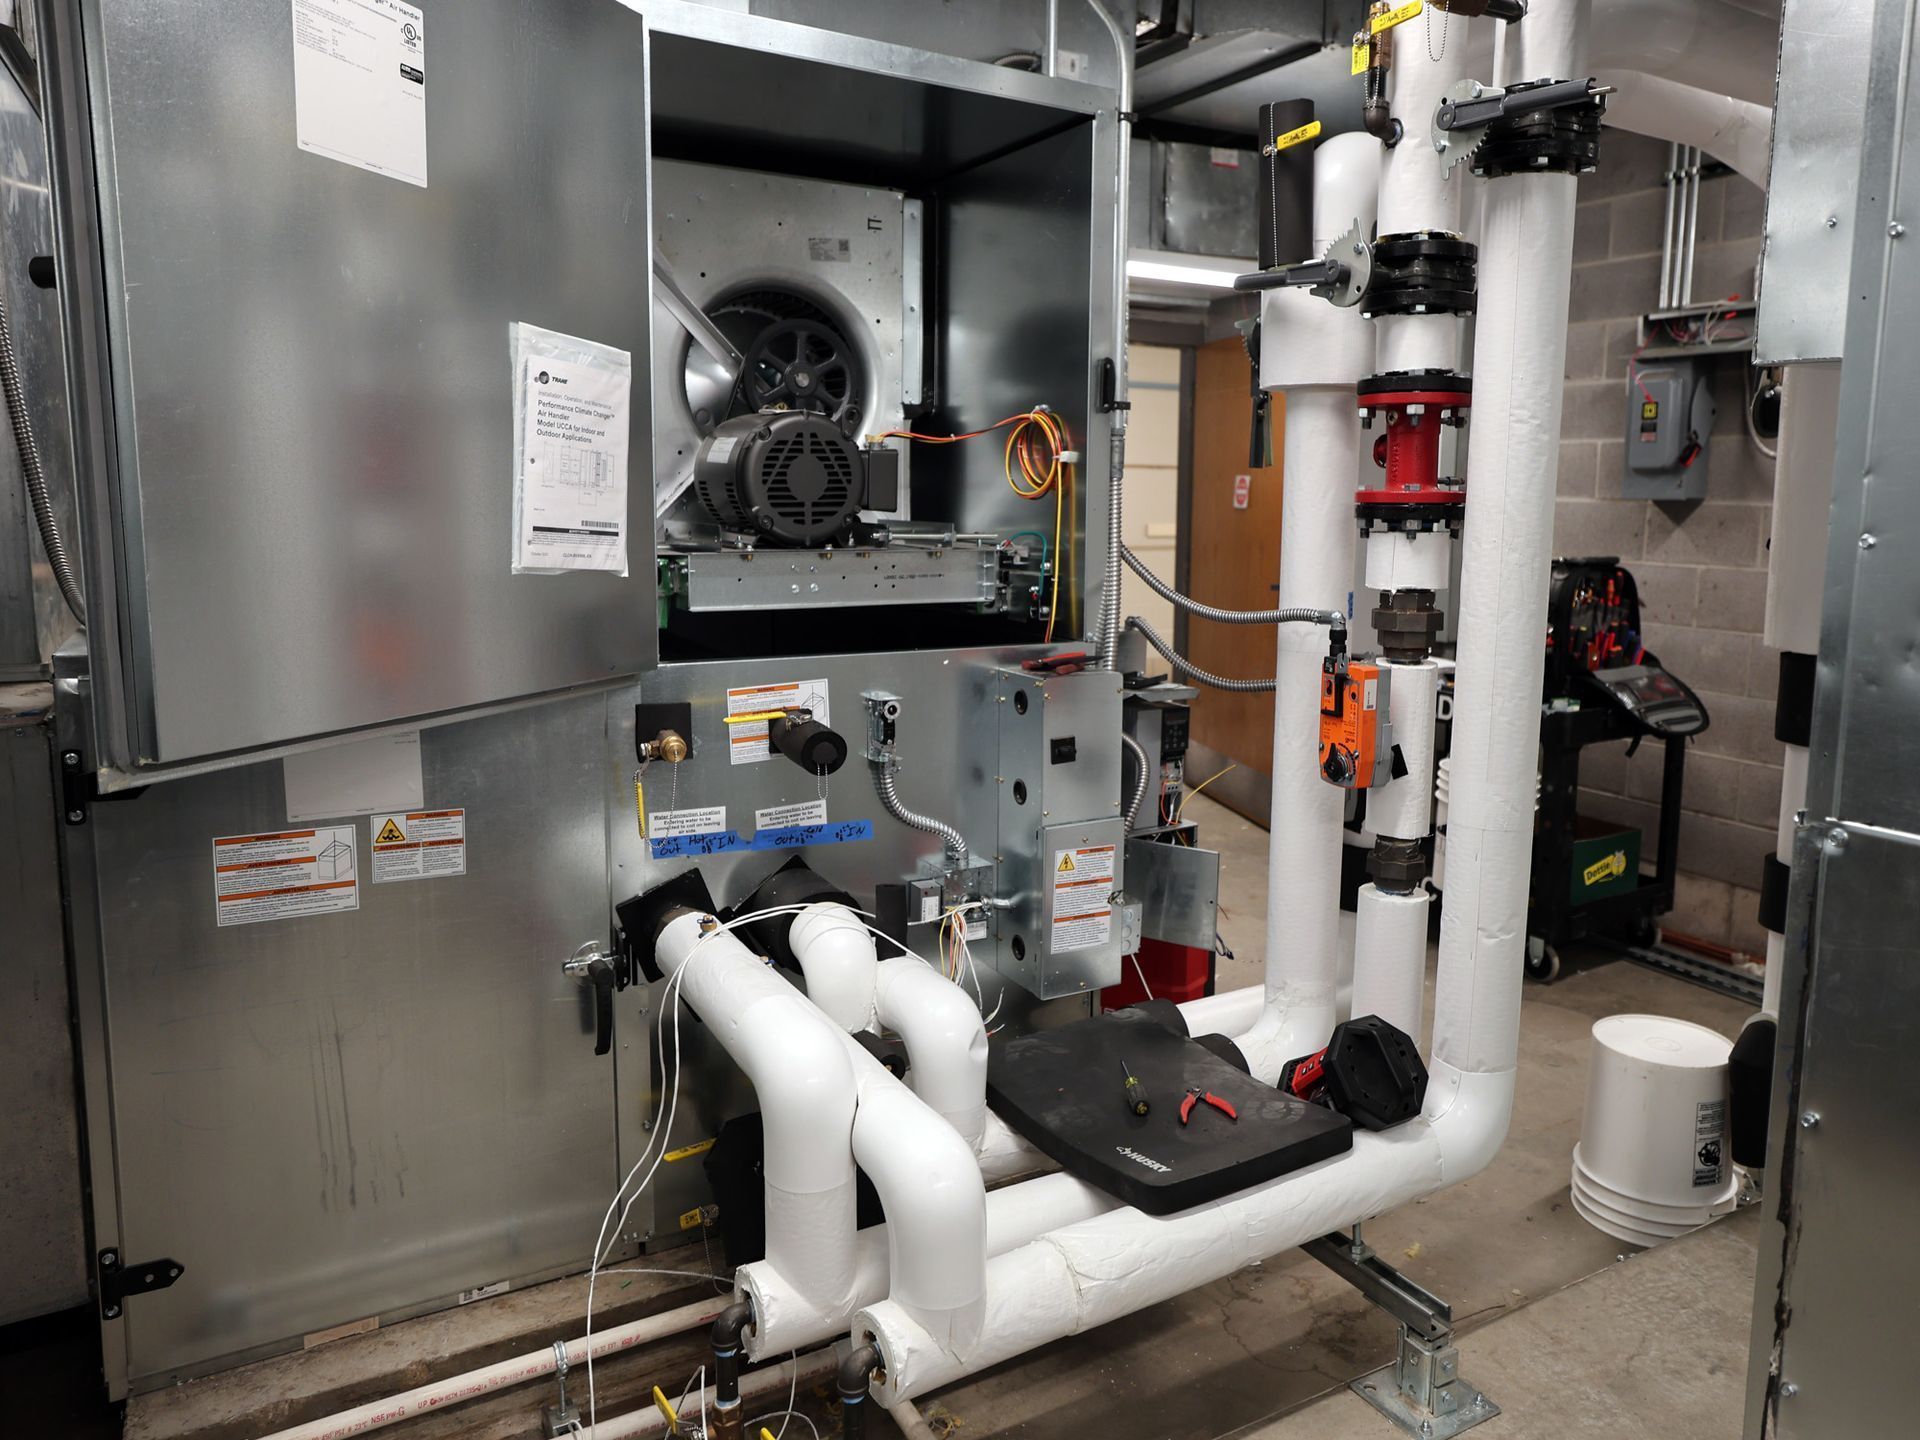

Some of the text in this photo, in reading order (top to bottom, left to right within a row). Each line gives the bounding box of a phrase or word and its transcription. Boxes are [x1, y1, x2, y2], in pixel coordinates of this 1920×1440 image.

[390, 3, 420, 20] Air Handler
[538, 400, 574, 412] Performance
[574, 406, 593, 416] Climate
[538, 409, 570, 421] Air Handler
[537, 419, 556, 428] Model
[556, 422, 573, 431] UCCA
[581, 426, 596, 435] Indoor
[536, 428, 592, 444] Outdoor Applications
[775, 808, 801, 816] Connection
[688, 834, 709, 846] Hot
[1587, 862, 1612, 880] Dottie
[1126, 1152, 1172, 1173] HUSKY
[335, 1427, 345, 1438] PSI
